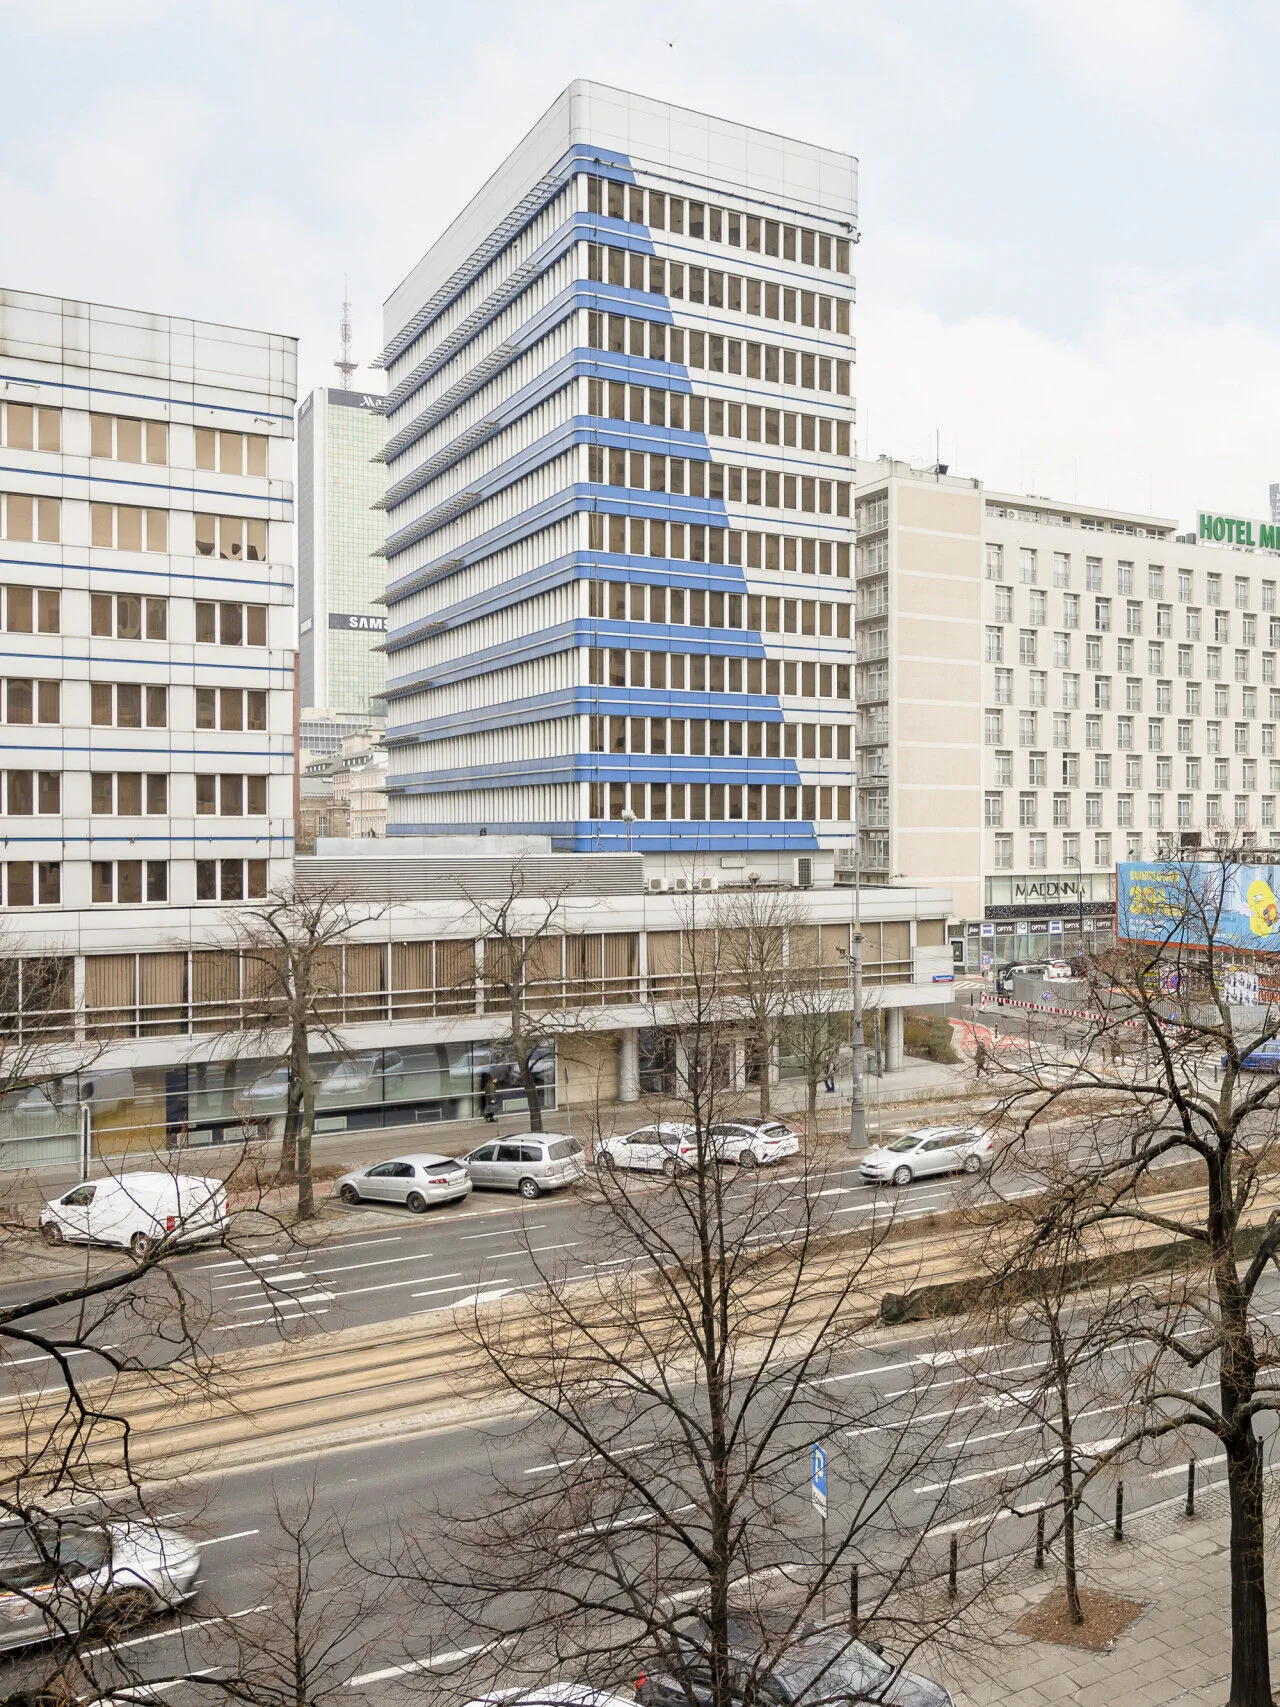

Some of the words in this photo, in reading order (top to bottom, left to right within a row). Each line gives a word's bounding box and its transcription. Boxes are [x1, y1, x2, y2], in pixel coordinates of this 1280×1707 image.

[1200, 513, 1255, 546] HOTEL
[1015, 881, 1085, 897] MADONNA
[997, 925, 1014, 933] OPTYK
[1031, 922, 1047, 931] OPTYK
[1064, 921, 1081, 929] OPTYK
